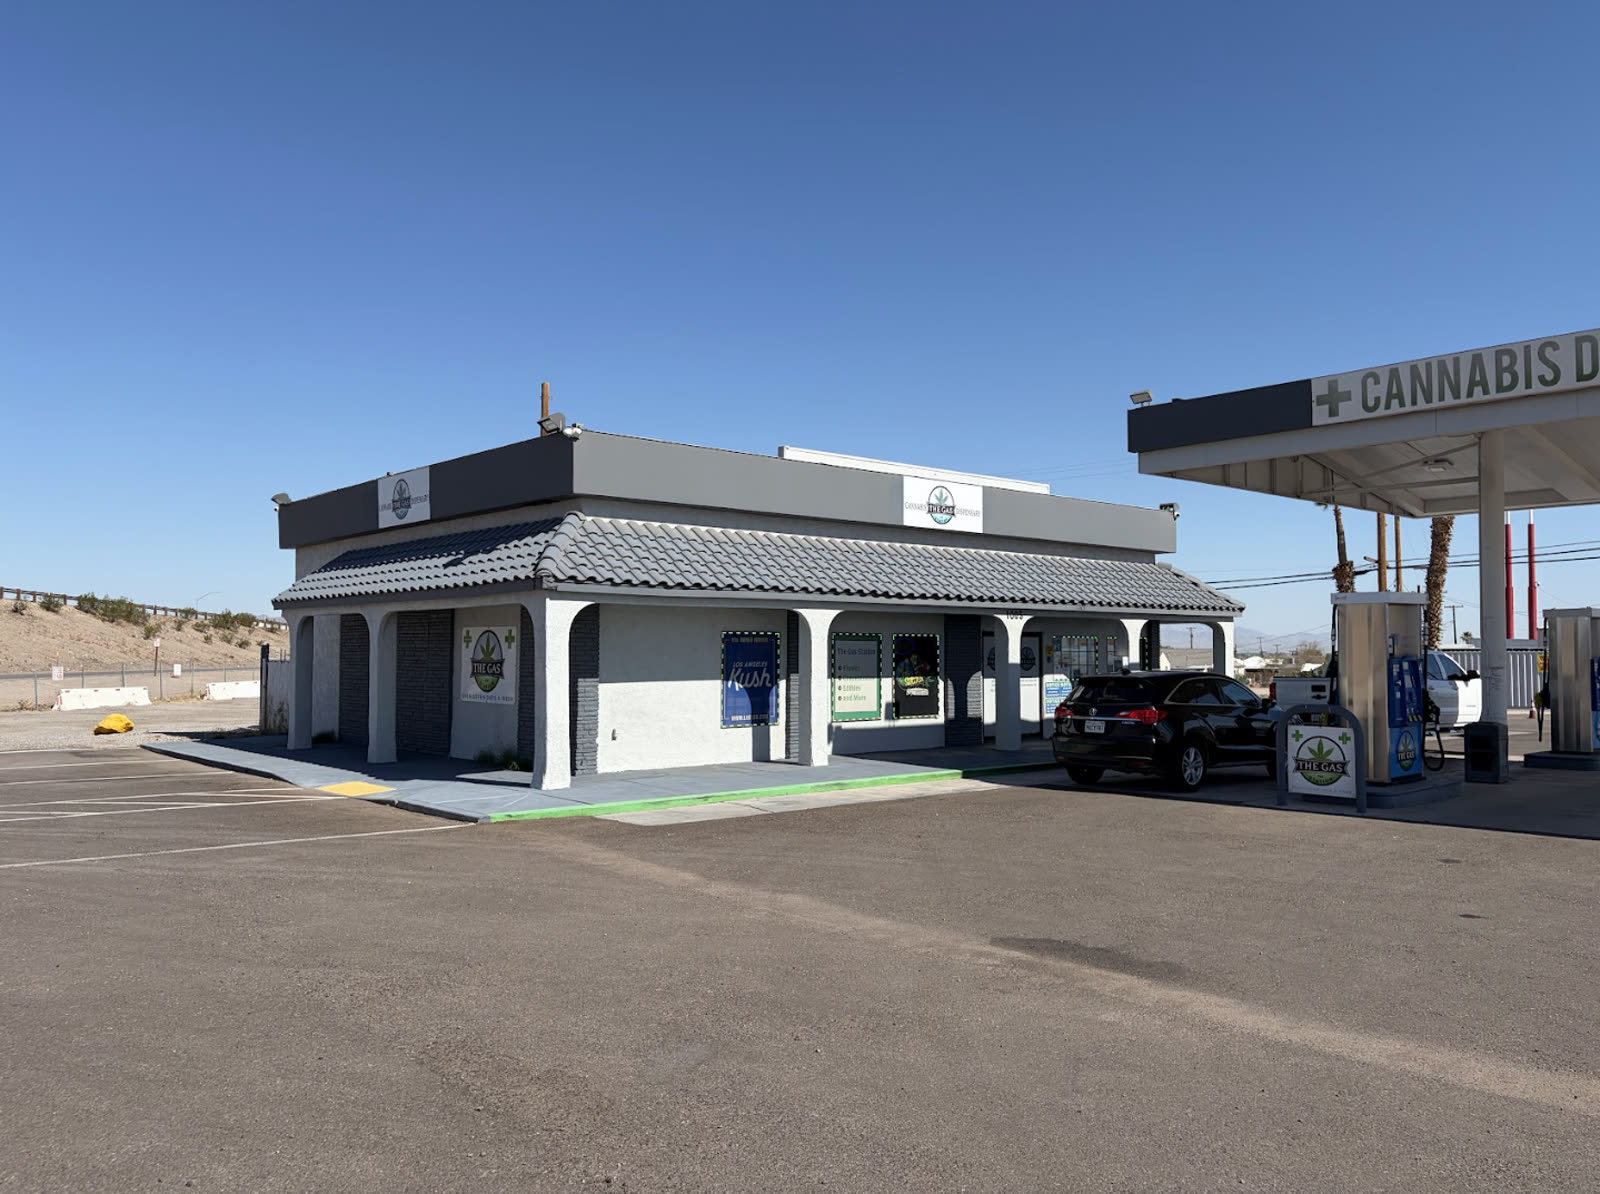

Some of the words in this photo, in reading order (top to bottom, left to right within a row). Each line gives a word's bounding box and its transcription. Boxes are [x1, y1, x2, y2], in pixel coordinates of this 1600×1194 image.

[1361, 340, 1562, 413] CANNABIS
[473, 663, 487, 673] THE
[487, 663, 501, 674] GAS
[727, 667, 772, 691] Kush
[1299, 761, 1319, 771] THE
[1321, 762, 1343, 773] GAS
